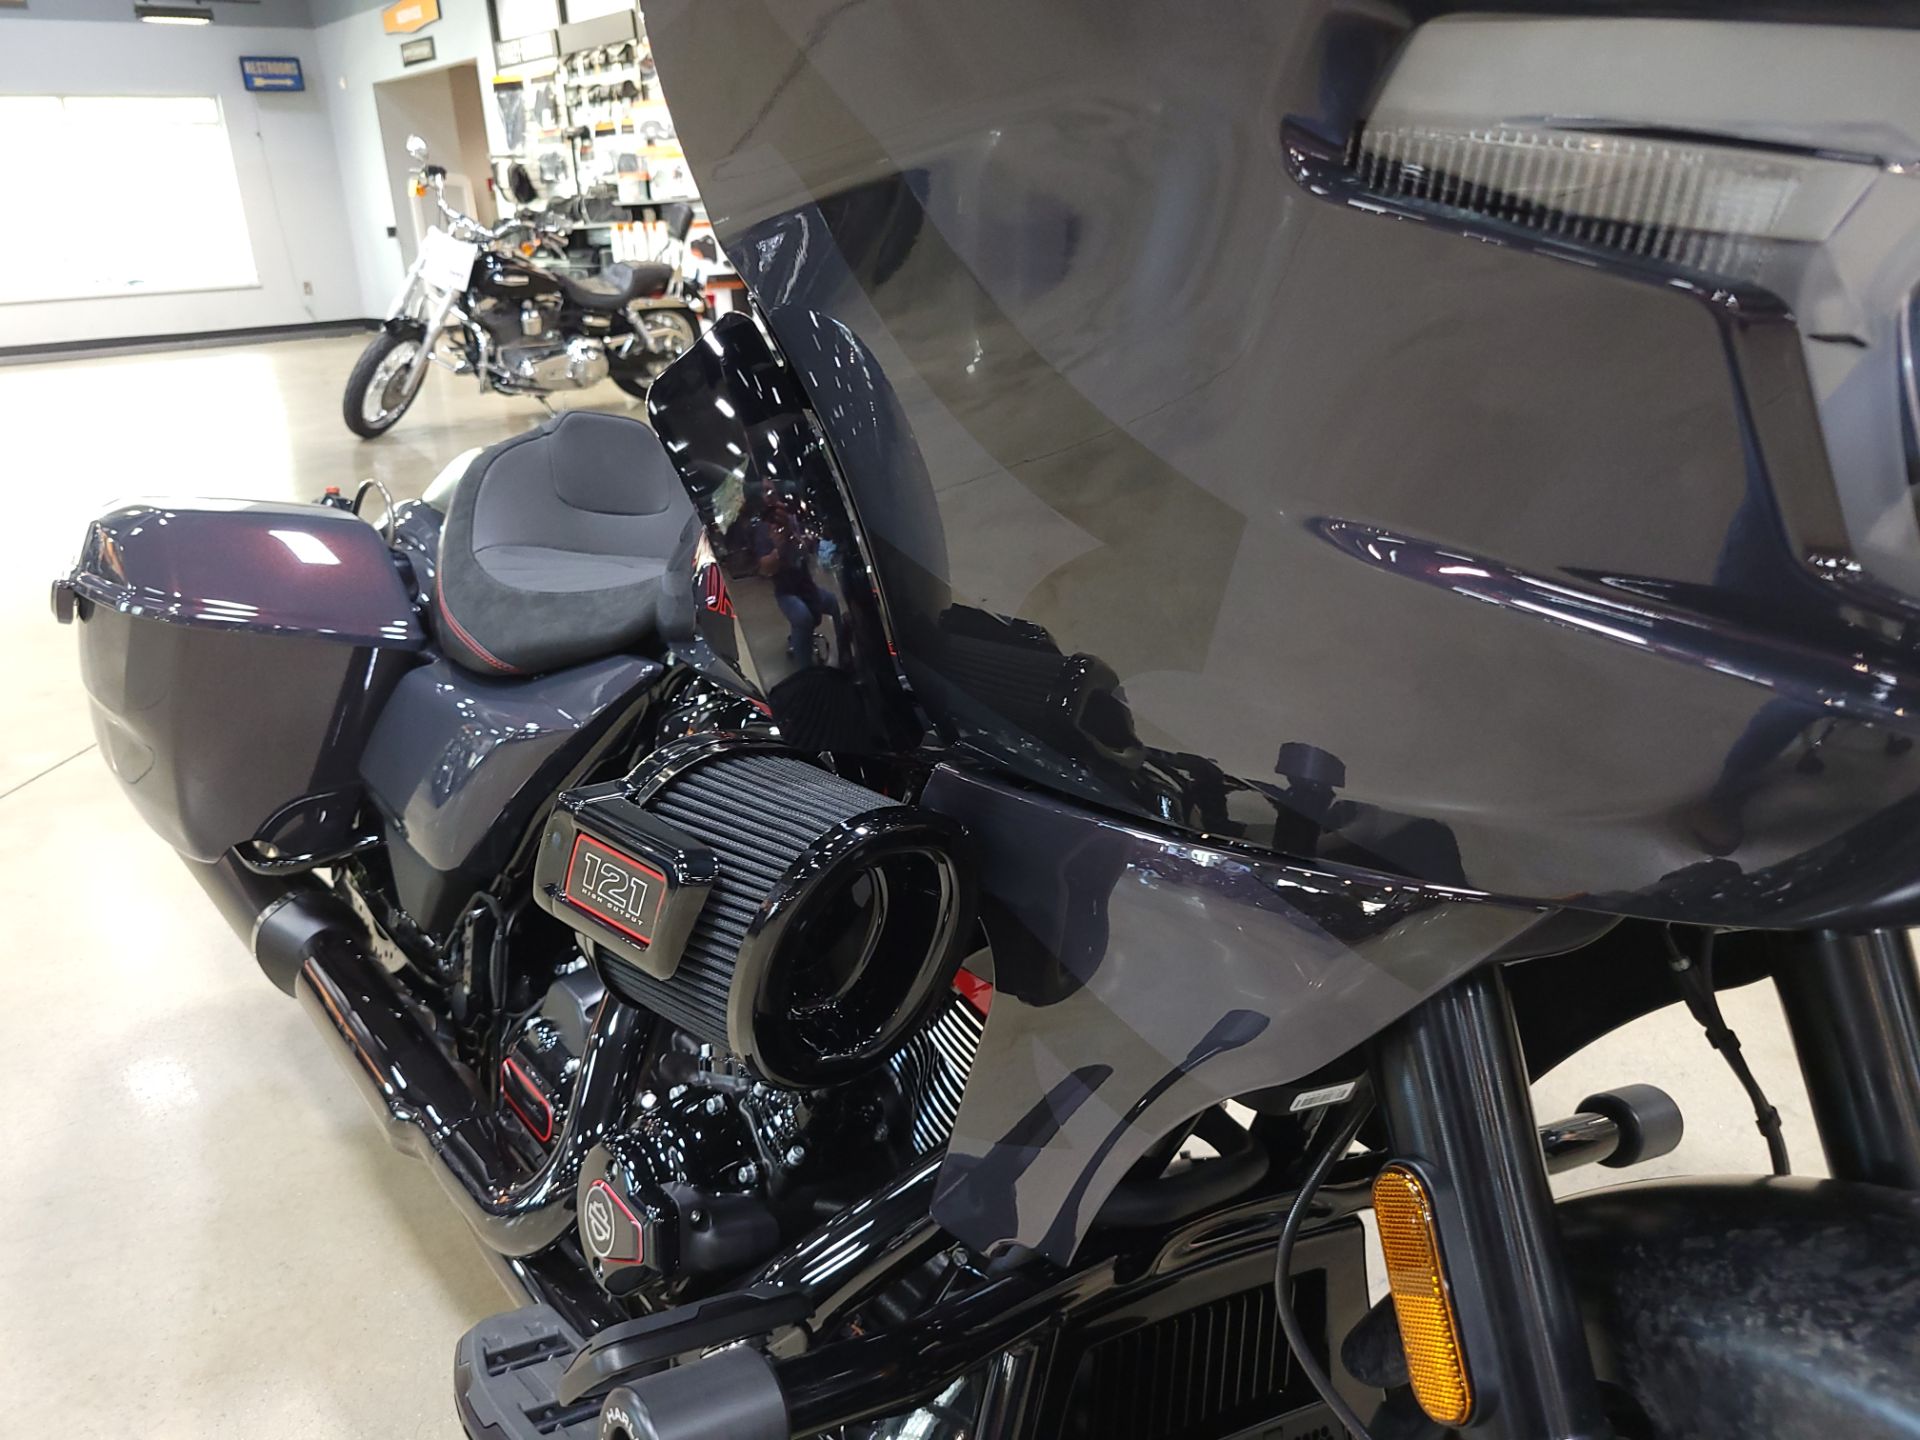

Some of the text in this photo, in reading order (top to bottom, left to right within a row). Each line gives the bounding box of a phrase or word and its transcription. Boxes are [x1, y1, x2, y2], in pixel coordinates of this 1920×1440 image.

[582, 852, 648, 917] 121
[581, 888, 644, 926] HIGH OUTPUT
[606, 1407, 639, 1440] HARL
